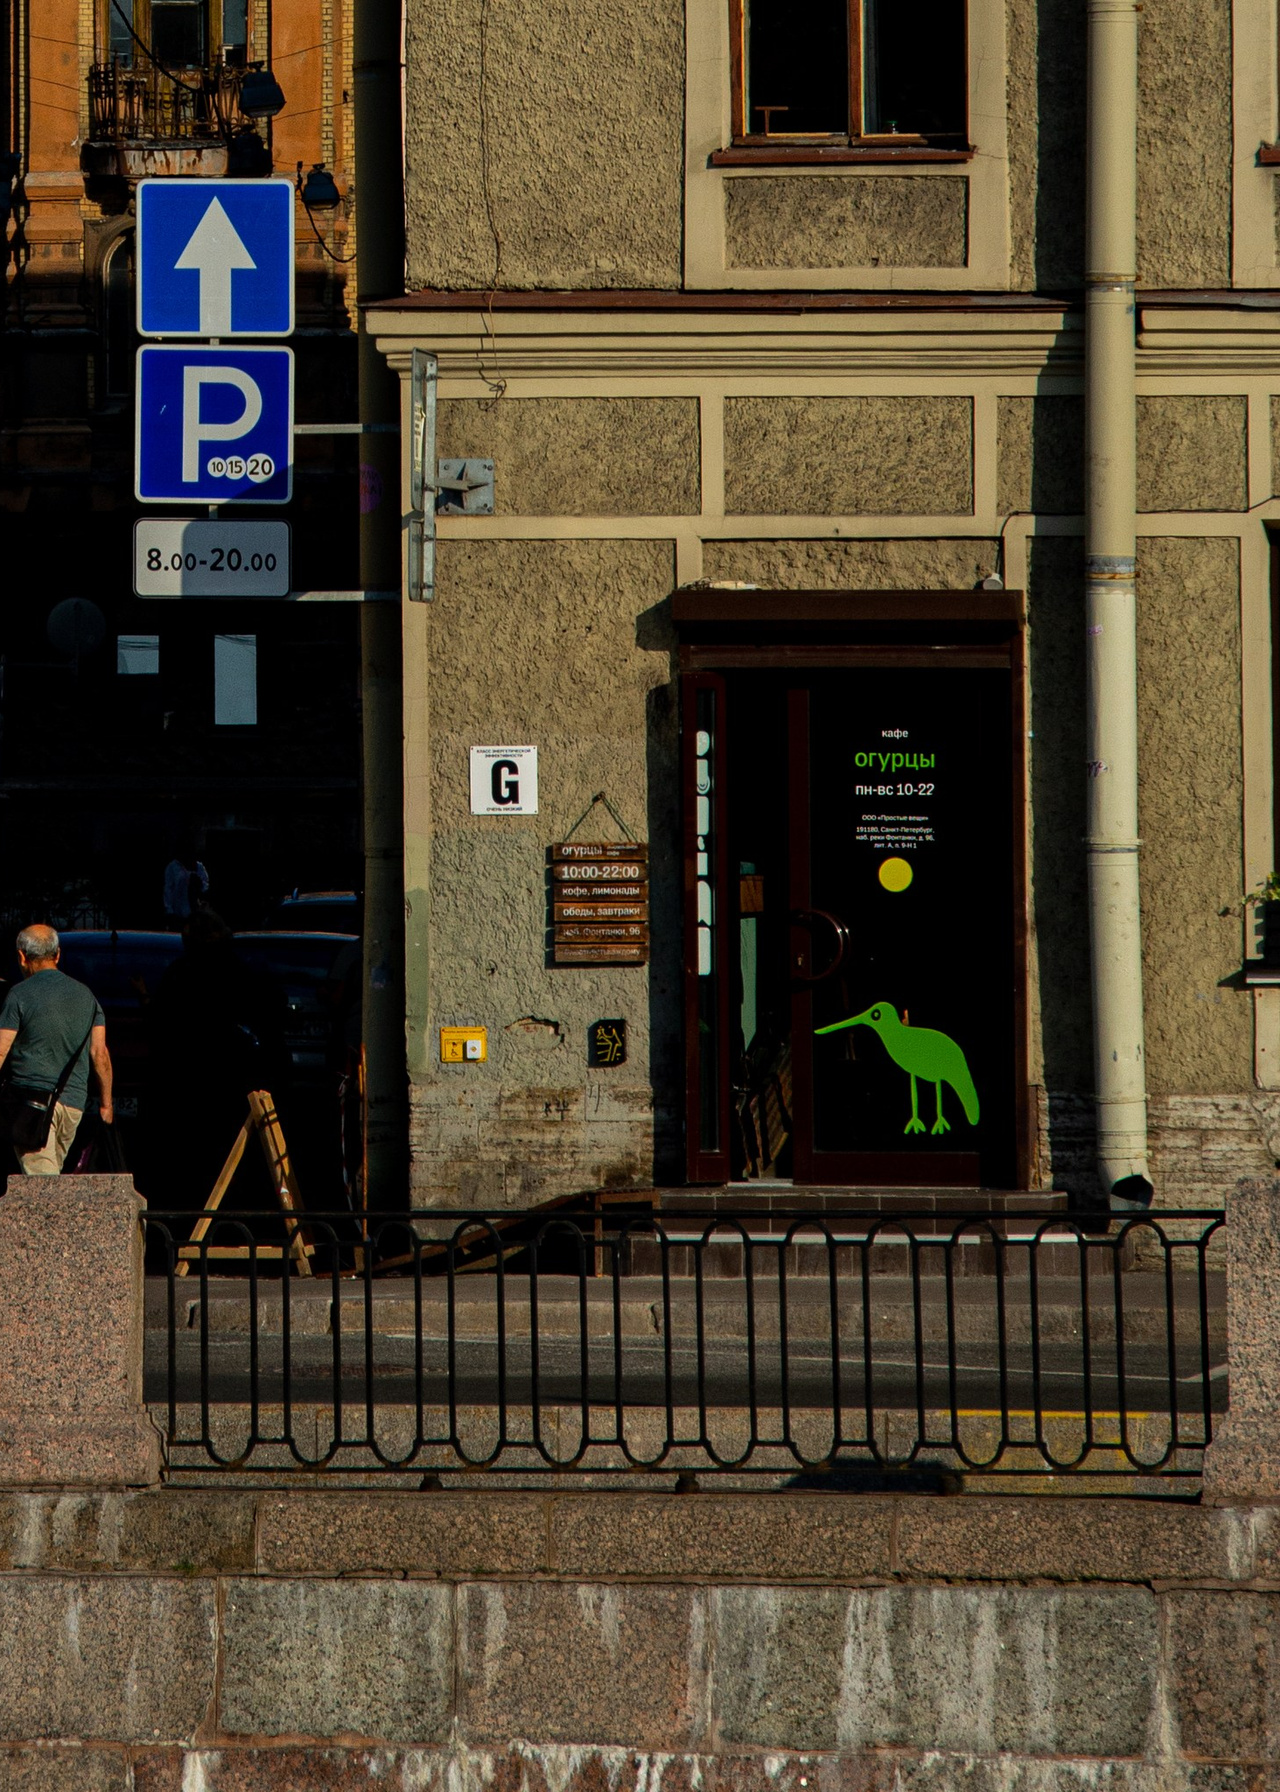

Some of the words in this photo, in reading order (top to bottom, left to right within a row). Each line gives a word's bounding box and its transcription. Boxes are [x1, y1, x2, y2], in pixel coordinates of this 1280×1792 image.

[182, 365, 263, 483] P
[211, 460, 224, 474] 10
[228, 460, 243, 475] 15
[249, 458, 272, 476] 20
[146, 547, 277, 573] 8.00-20.00
[881, 728, 909, 739] кафе
[854, 751, 935, 773] огурцы
[491, 759, 519, 806] G
[854, 784, 895, 796] пн-вс
[896, 783, 936, 796] 10-22
[561, 846, 603, 857] огурцы
[561, 865, 639, 879] 10:00-22:00
[562, 886, 590, 897] кофе,
[591, 887, 640, 896] лимонады
[562, 907, 596, 917] обеды,
[597, 907, 640, 917] завтраки
[629, 926, 641, 936] 96
